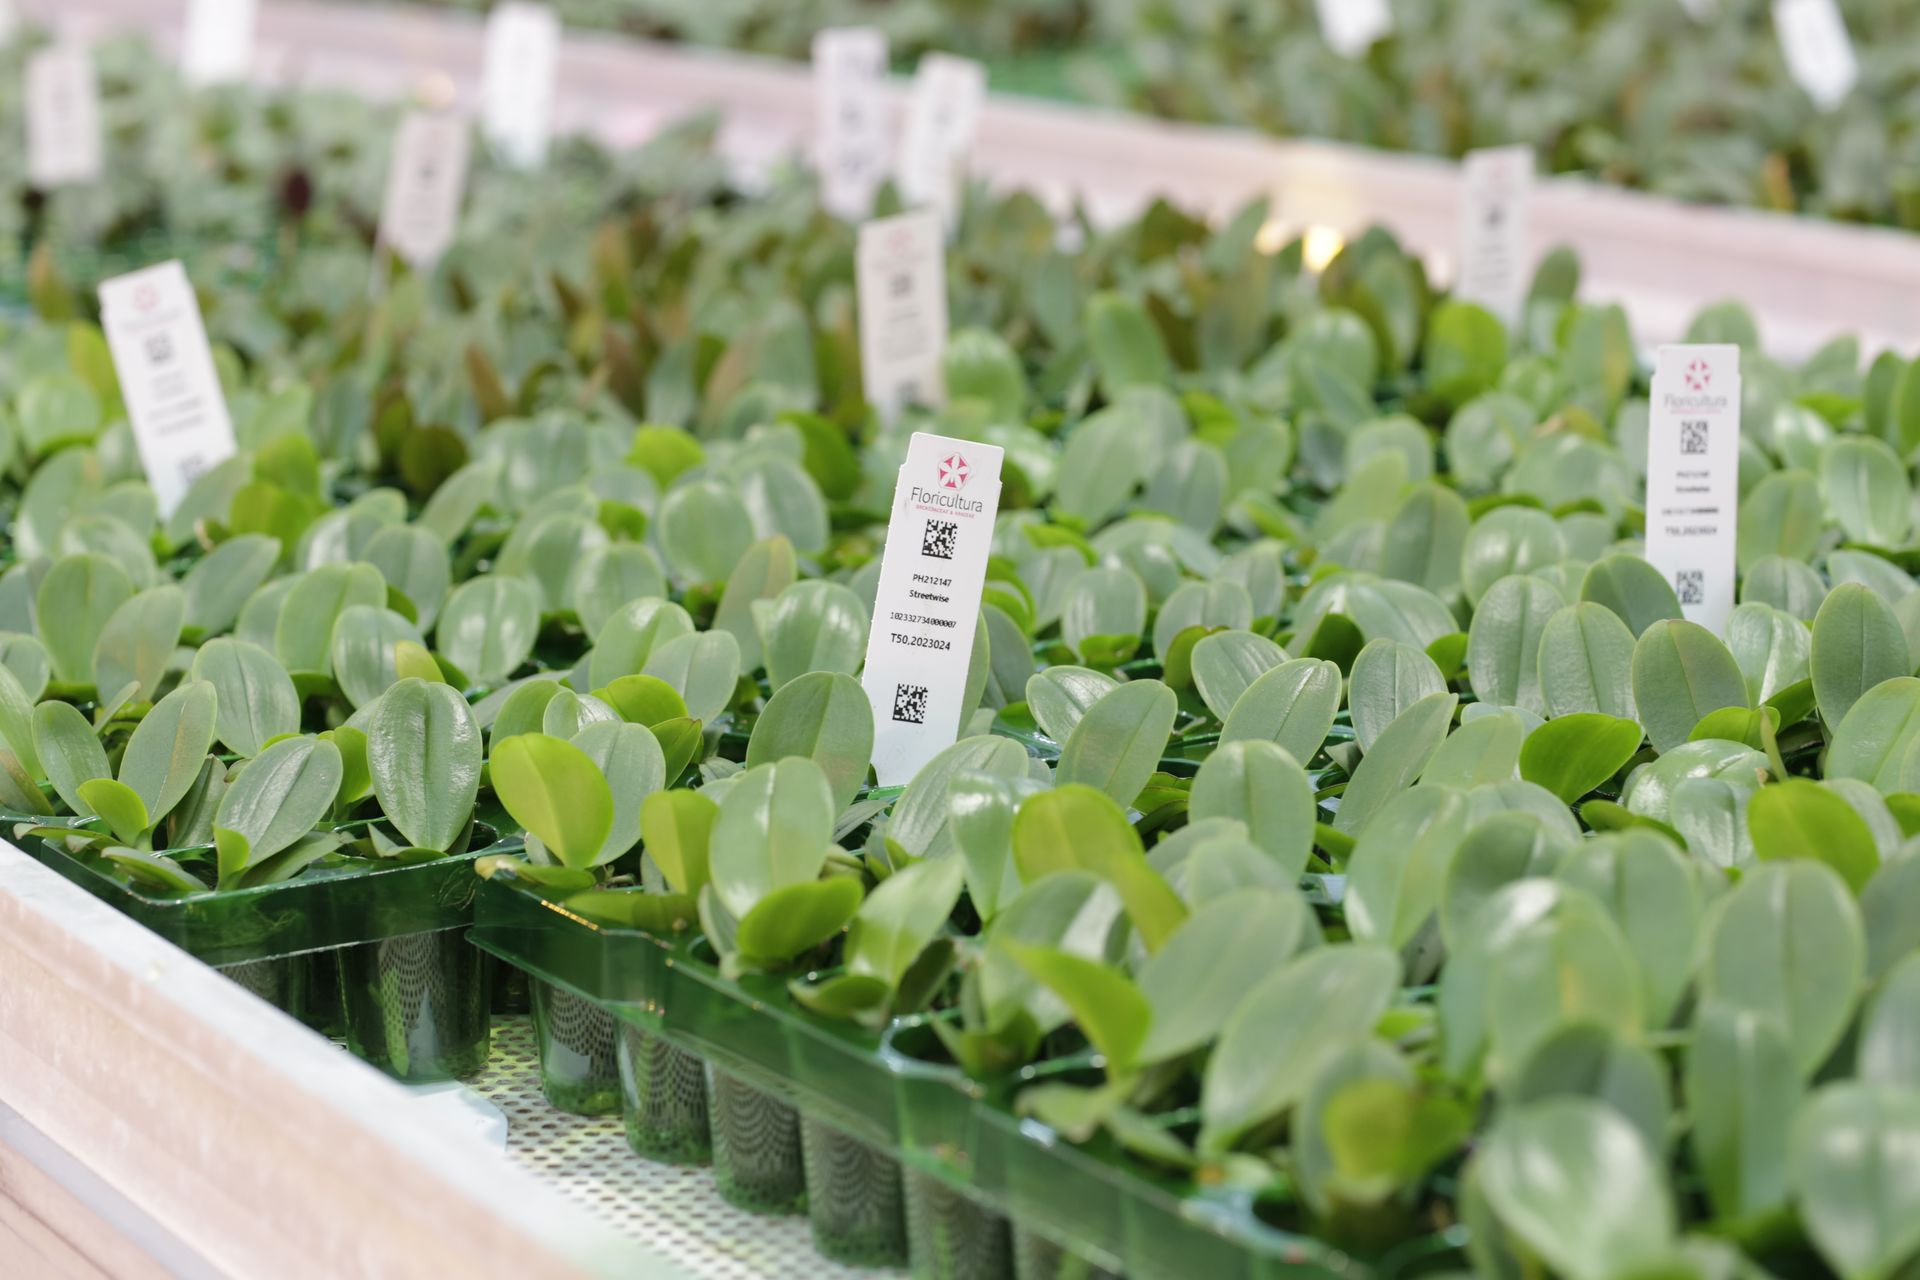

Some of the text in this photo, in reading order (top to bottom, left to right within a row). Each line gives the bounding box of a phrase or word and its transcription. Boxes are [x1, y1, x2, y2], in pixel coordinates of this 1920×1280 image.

[911, 487, 983, 513] Floricultura
[912, 573, 953, 587] PH212147
[909, 589, 950, 603] Streetwise
[891, 632, 951, 651] T50.2023024
